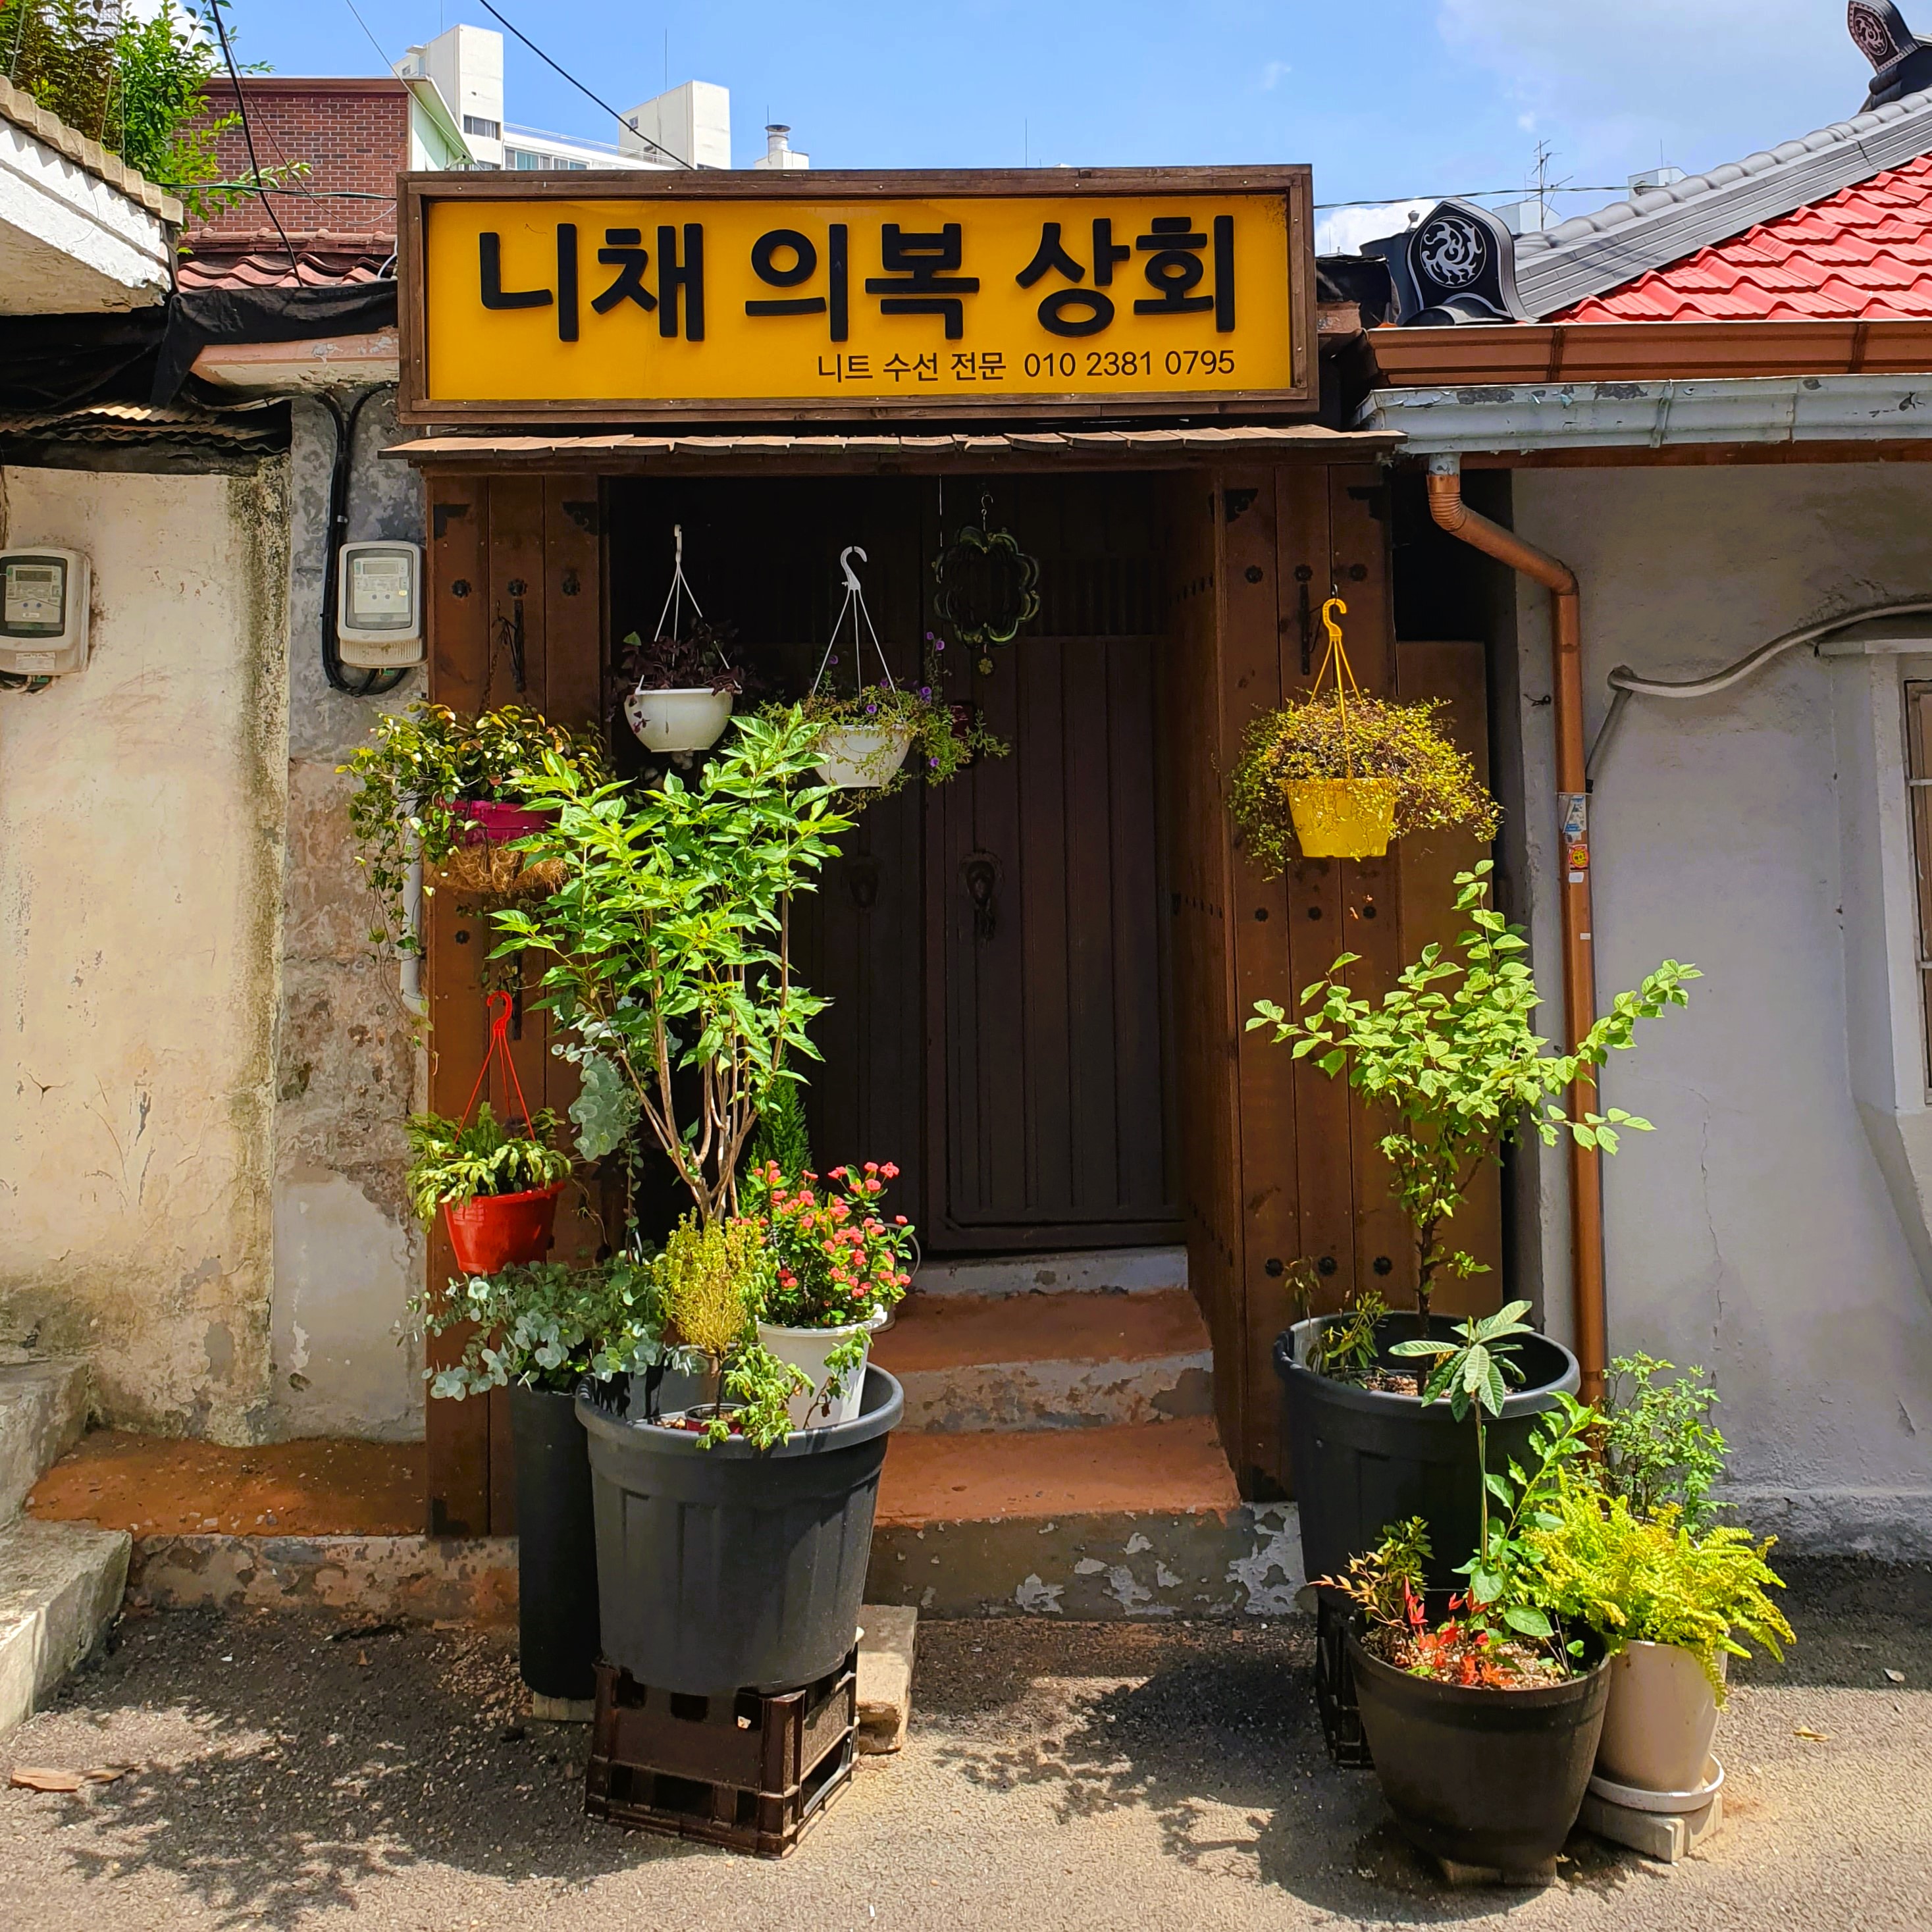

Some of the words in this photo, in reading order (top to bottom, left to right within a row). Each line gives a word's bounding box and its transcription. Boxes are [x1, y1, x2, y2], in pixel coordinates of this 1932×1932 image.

[479, 222, 706, 342] 니채
[744, 222, 980, 343] 의복
[1015, 215, 1236, 338] 상회
[818, 354, 873, 383] 니트
[883, 353, 938, 382] 수선
[950, 352, 1007, 381] 전문
[1024, 352, 1076, 377] 010
[1086, 351, 1151, 377] 2381
[1165, 350, 1235, 376] 0795
